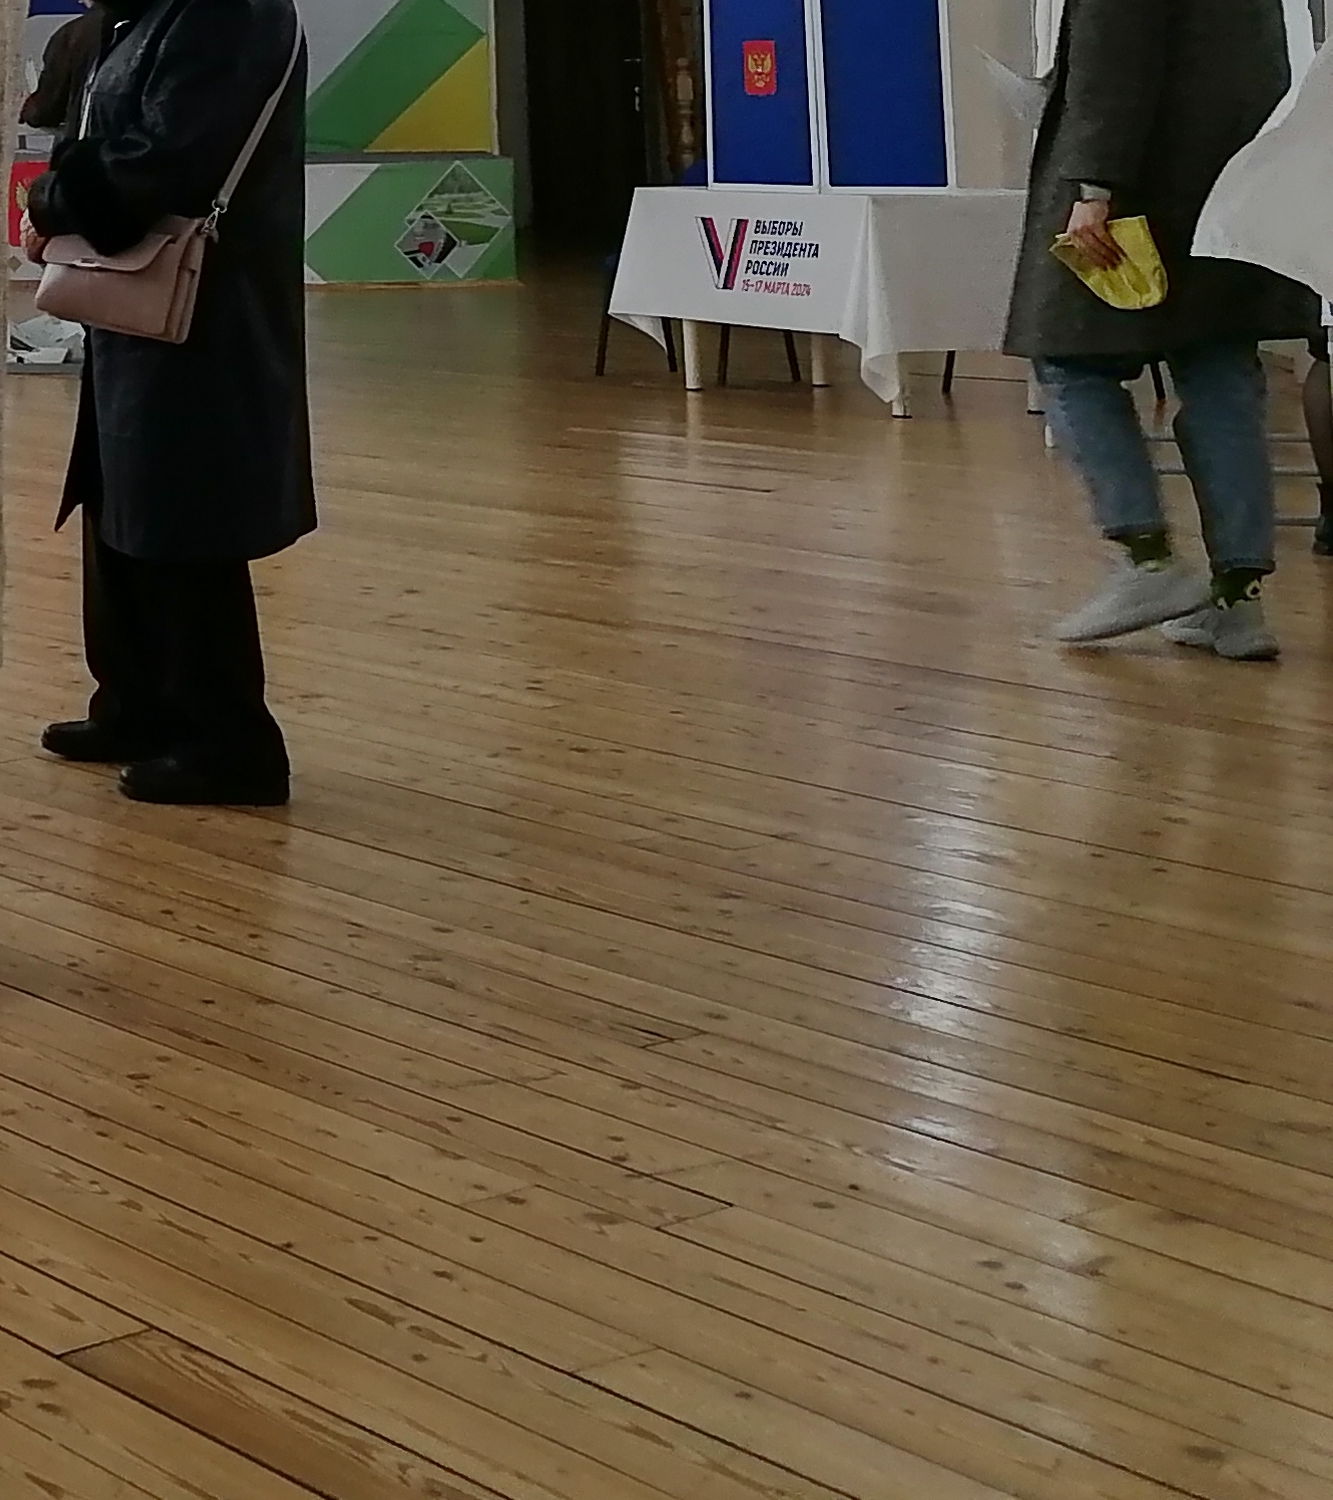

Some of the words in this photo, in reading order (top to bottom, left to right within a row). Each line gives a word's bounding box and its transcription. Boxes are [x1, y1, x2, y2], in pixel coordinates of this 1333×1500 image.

[753, 219, 804, 236] ВЫБОРЫ
[749, 240, 820, 258] ПРЕЗИДЕНТА
[744, 260, 789, 277] РОССИИ
[763, 281, 790, 295] МАРТА
[791, 283, 812, 297] 2024
